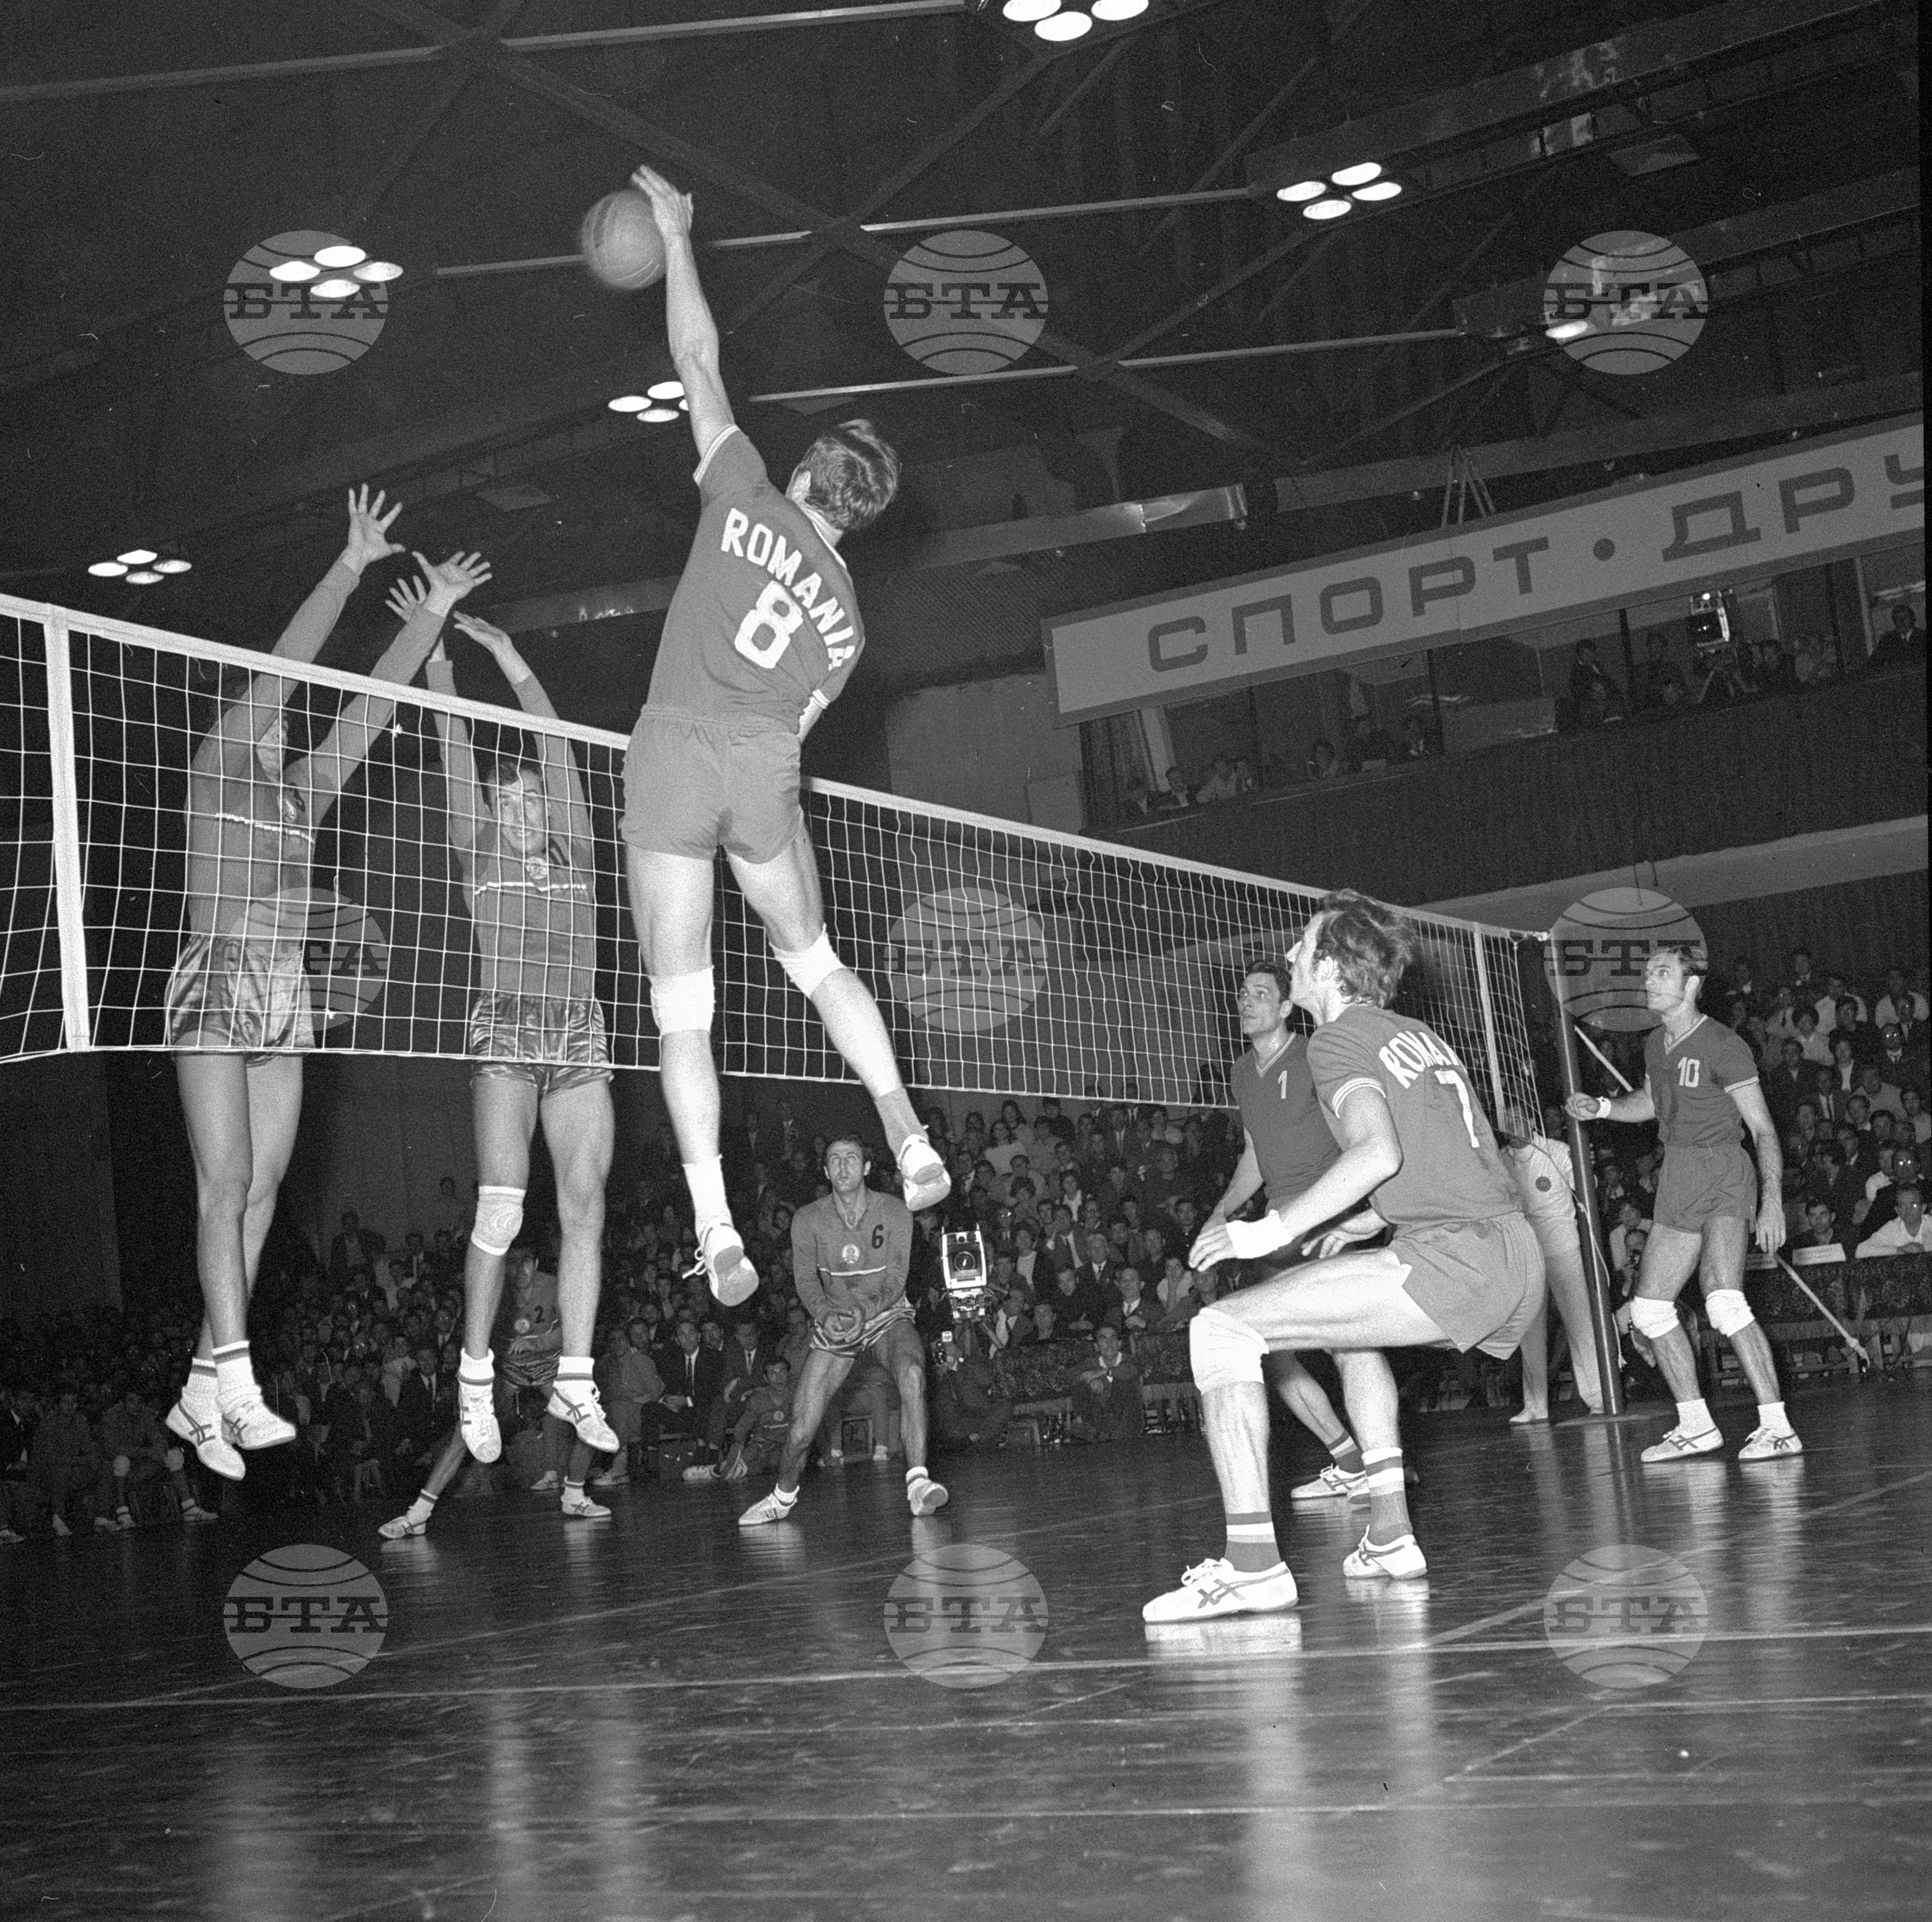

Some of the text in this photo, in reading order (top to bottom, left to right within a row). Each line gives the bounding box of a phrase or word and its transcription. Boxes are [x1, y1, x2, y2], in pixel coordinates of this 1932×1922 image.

[721, 508, 855, 670] ROMANIA
[1148, 536, 1549, 673] СПОРТ
[735, 581, 803, 669] 8
[1278, 1070, 1287, 1099] 1
[1678, 1057, 1700, 1087] 10
[1434, 1069, 1479, 1148] 7
[871, 1224, 884, 1249] 6
[535, 1306, 545, 1324] 2
